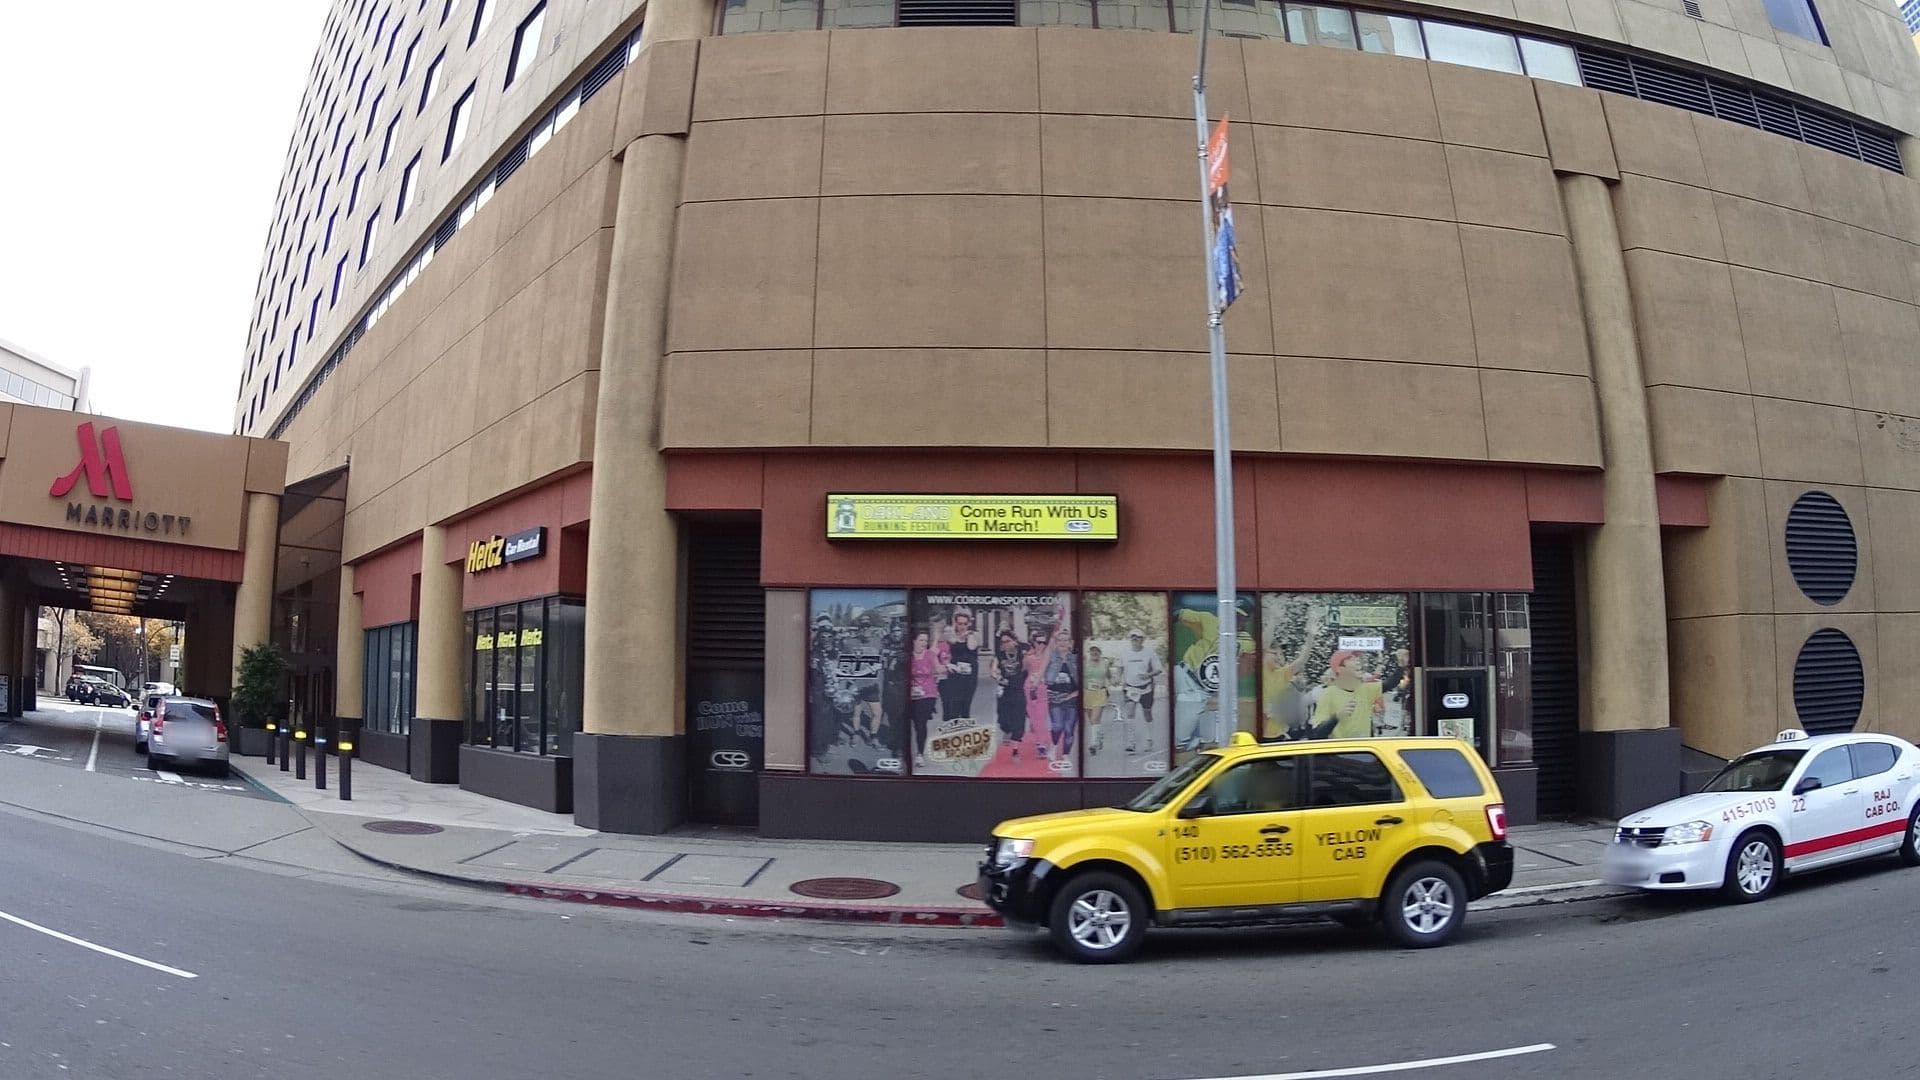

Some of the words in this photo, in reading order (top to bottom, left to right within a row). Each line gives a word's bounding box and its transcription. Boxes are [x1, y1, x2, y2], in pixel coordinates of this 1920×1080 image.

[66, 502, 192, 536] MARRIOTT
[960, 505, 1006, 518] Come
[1011, 505, 1042, 518] Run
[1047, 506, 1082, 519] With
[1087, 506, 1108, 519] Us
[965, 519, 979, 532] in
[983, 519, 1039, 532] March!
[505, 542, 517, 557] Car
[516, 533, 540, 553] Rental
[467, 535, 505, 573] Hertz
[476, 633, 494, 650] Hertz
[497, 630, 517, 648] Hertz
[520, 627, 542, 646] Hertz
[700, 701, 748, 715] Come
[932, 728, 991, 752] BROADS
[1779, 731, 1796, 741] TAXI
[1873, 788, 1891, 802] RAJ
[1722, 797, 1777, 823] 415-7019
[1792, 798, 1807, 812] 22
[1865, 804, 1884, 819] CAB
[1886, 800, 1901, 813] CO.
[1173, 825, 1199, 839] 140
[1315, 829, 1382, 846] YELLOW
[1174, 846, 1217, 865] (510)
[1221, 843, 1294, 859] 562-5555
[1333, 846, 1367, 861] CAB
